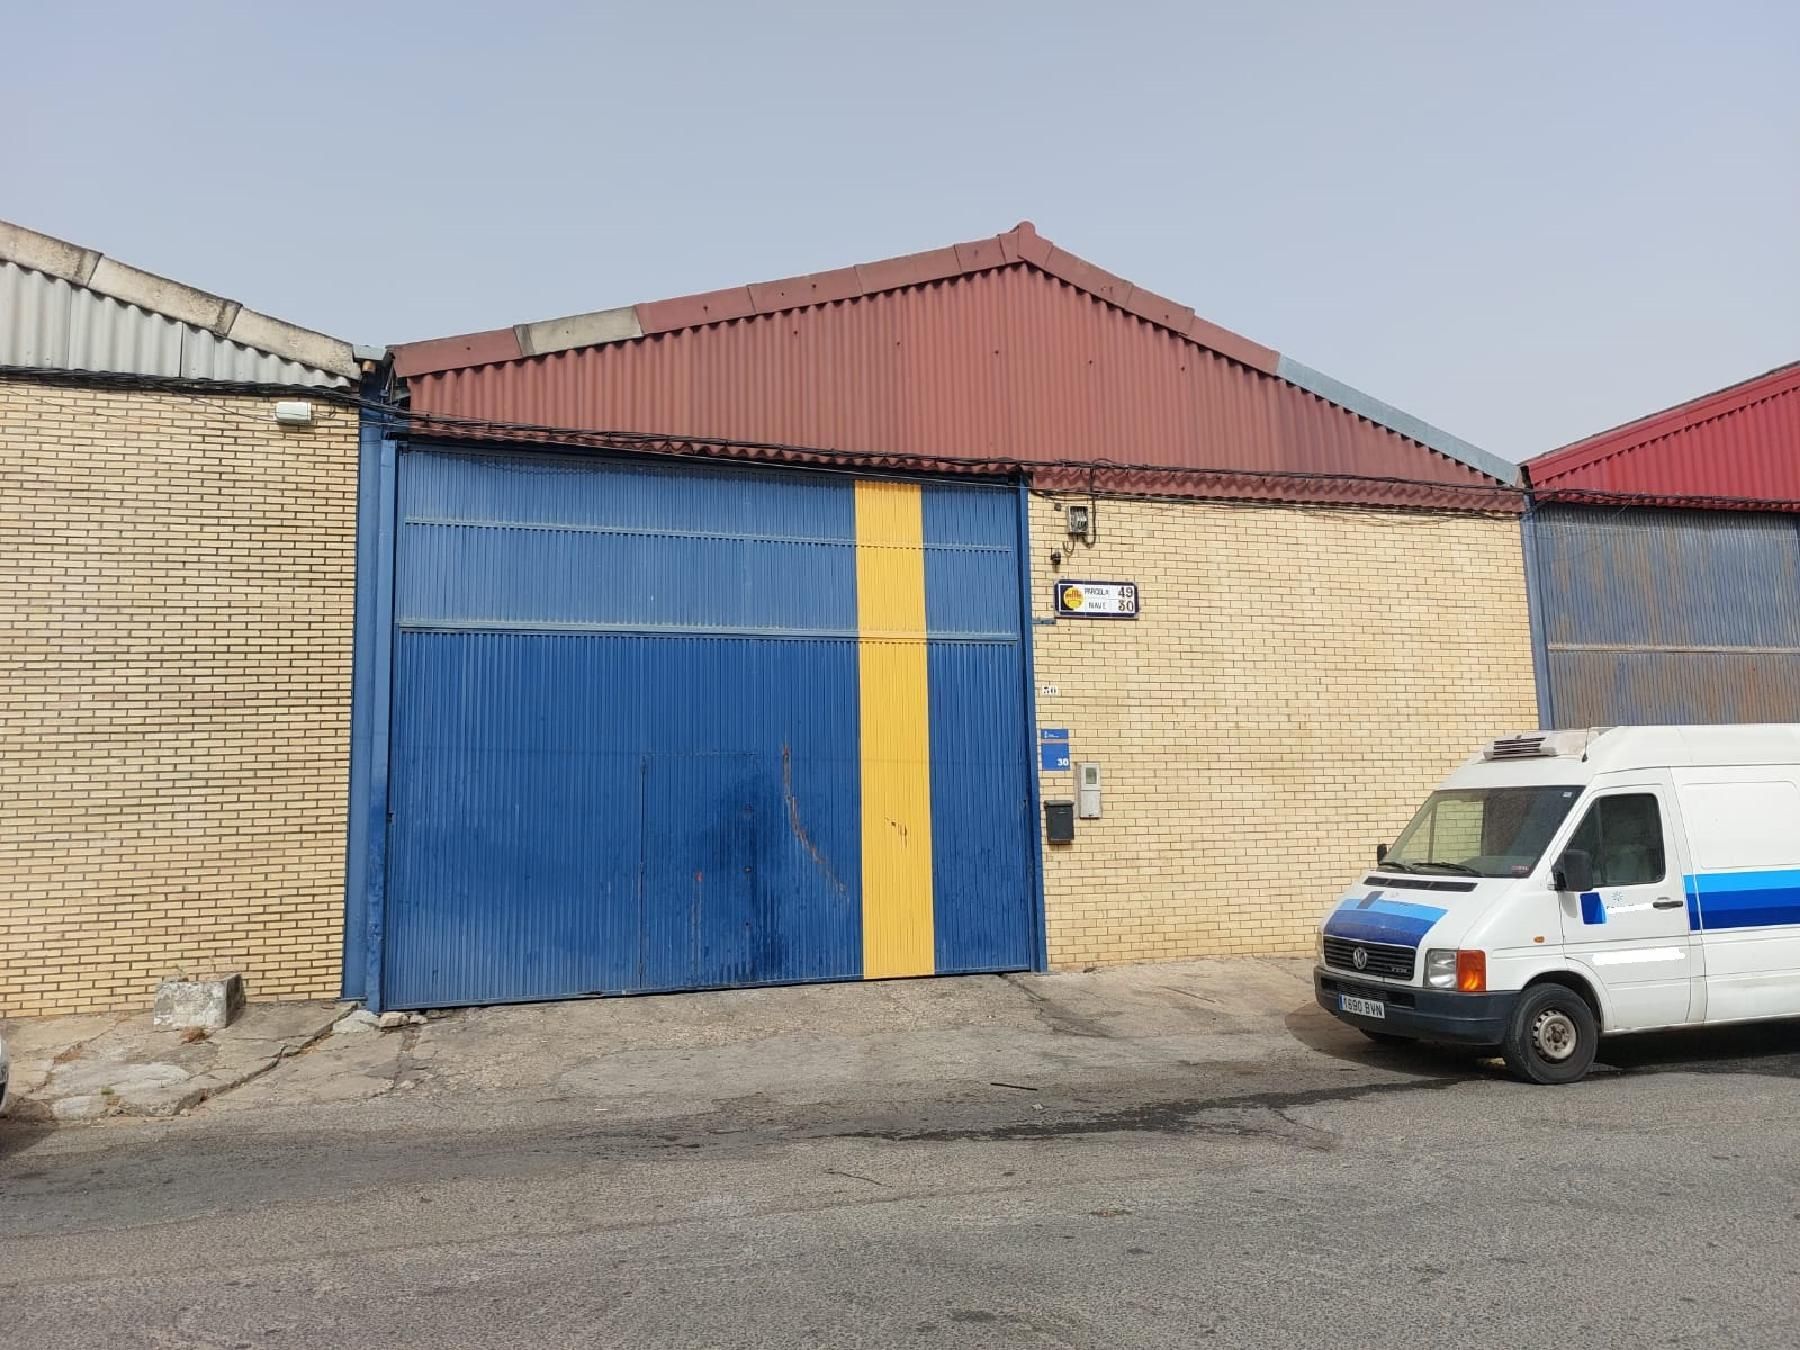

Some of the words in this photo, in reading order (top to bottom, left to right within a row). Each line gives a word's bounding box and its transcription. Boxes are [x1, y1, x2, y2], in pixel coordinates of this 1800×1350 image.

[1118, 587, 1133, 598] 49
[1118, 600, 1134, 611] 30
[1057, 758, 1069, 766] 30
